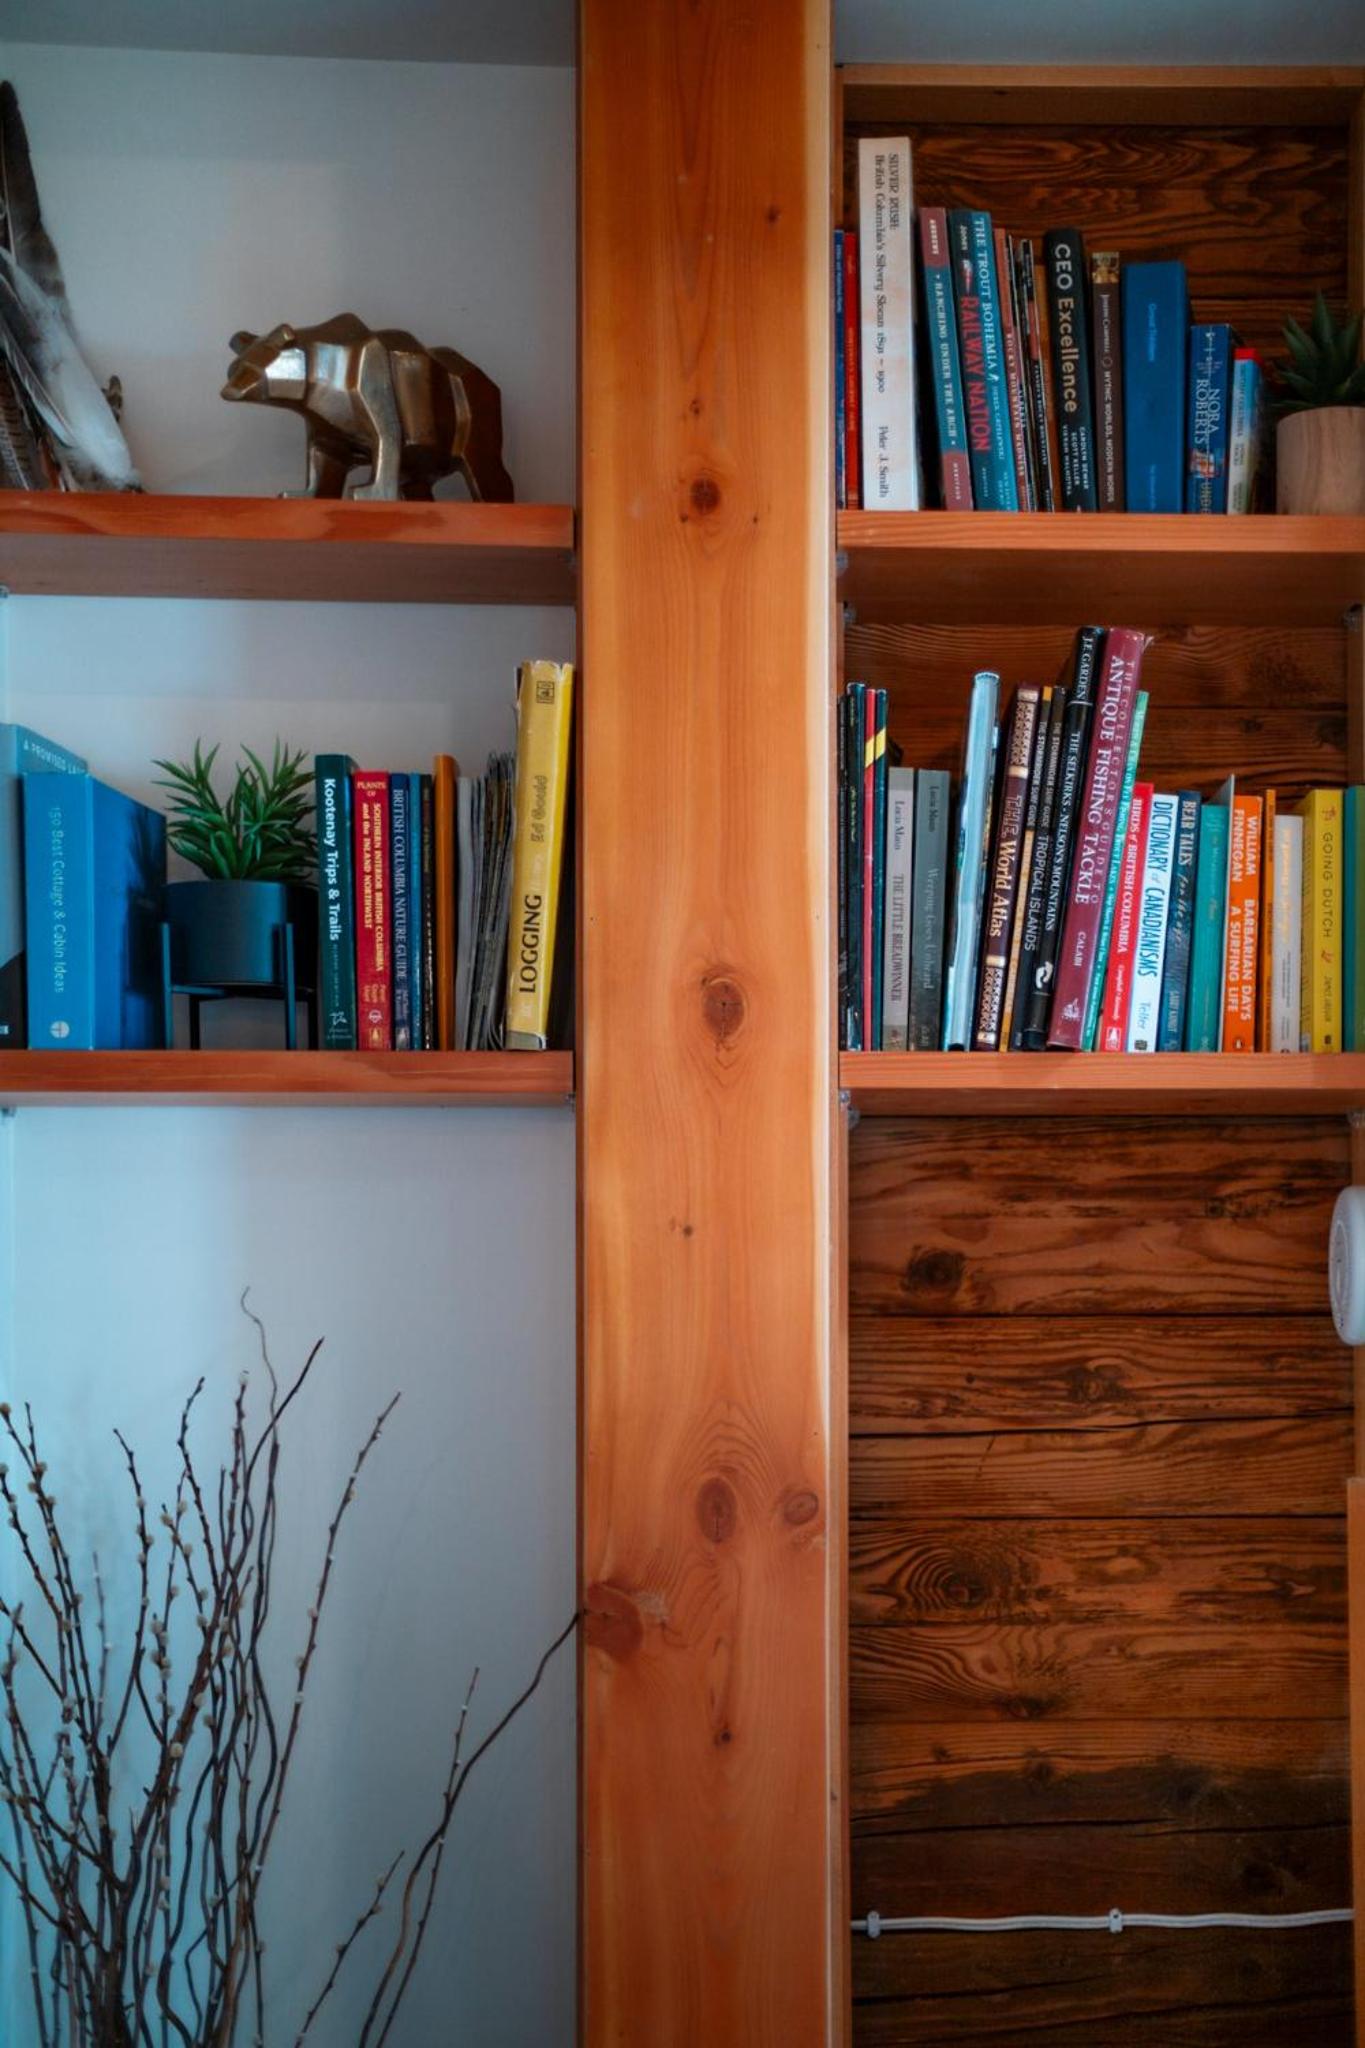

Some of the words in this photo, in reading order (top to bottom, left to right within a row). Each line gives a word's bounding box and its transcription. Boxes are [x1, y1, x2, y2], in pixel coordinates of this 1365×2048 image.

[875, 154, 886, 189] British
[888, 153, 900, 194] SILVER
[875, 193, 886, 251] Columbia's
[888, 197, 900, 230] RUSH:
[974, 217, 987, 247] THE
[873, 254, 885, 291] Silvery
[977, 250, 992, 300] TROUT
[1055, 243, 1073, 290] CEO
[934, 282, 948, 339] RANCHING
[960, 296, 984, 375] RAILWAY
[982, 302, 998, 369] BOHEMIA
[1058, 297, 1079, 413] Excellence
[940, 343, 953, 379] UNDER
[943, 383, 954, 405] THE
[967, 381, 992, 452] NATION
[1195, 379, 1209, 444] ROBERTS
[1208, 388, 1221, 434] NORA
[878, 426, 889, 450] Peter
[946, 408, 957, 437] ARCH
[879, 466, 891, 498] Smith
[1076, 653, 1092, 700] GARDEN
[1100, 655, 1124, 741] ANTIQUE
[1123, 660, 1135, 693] THE
[1037, 721, 1047, 735] THE
[1069, 731, 1081, 753] THE
[1061, 755, 1077, 806] SELKIRKS
[1088, 749, 1112, 824] FISHING
[323, 778, 337, 847] Kootenay
[362, 802, 371, 820] and
[362, 821, 371, 835] the
[373, 802, 383, 849] SOUTHERN
[393, 788, 405, 833] BRITISH
[1131, 798, 1143, 833] BIRDS
[1181, 800, 1198, 829] BEAR
[51, 829, 65, 857] Best
[363, 837, 372, 873] INLAND
[1054, 814, 1070, 865] NELSON'S
[1094, 821, 1110, 875] GUIDE
[1148, 801, 1174, 872] DICTIONARY
[1177, 833, 1195, 866] TALES
[1231, 808, 1245, 882] FINNEGAN
[1245, 815, 1258, 875] WILLIAM
[1322, 832, 1334, 881] GOING
[51, 859, 65, 908] Cottage
[324, 851, 340, 885] Trips
[374, 850, 384, 889] INTERIOR
[393, 835, 406, 895] COLUMBIA
[892, 875, 905, 895] THE
[994, 839, 1018, 889] World
[1031, 835, 1049, 894] TROPICAL
[1075, 832, 1099, 905] TACKLE
[1123, 844, 1138, 890] BRITISH
[327, 888, 340, 900] &
[364, 875, 373, 929] NORTHWEST
[374, 892, 384, 924] BRITISH
[892, 896, 905, 928] LITTLE
[924, 868, 939, 912] Weeping
[1045, 865, 1062, 931] MOUNTAINS
[1090, 883, 1102, 904] TO
[1231, 906, 1241, 916] A
[54, 911, 66, 922] &
[329, 903, 343, 941] Trails
[395, 897, 407, 942] NATURE
[989, 893, 1012, 938] Atlas
[1024, 897, 1041, 951] ISLANDS
[1117, 890, 1133, 953] COLUMBIA
[1137, 887, 1165, 977] CANADIANISMS
[1322, 888, 1333, 938] DUTCH
[54, 925, 67, 959] Cabin
[375, 925, 385, 972] COLUMBIA
[395, 943, 408, 981] GUIDE
[519, 895, 542, 993] LOGGING
[1229, 921, 1241, 982] SURFING
[1242, 899, 1255, 980] BARBARIAN
[54, 962, 67, 994] Ideas
[891, 933, 905, 1002] BREADWINNER
[922, 944, 937, 989] Unheard
[1228, 987, 1239, 1012] LIFE
[1240, 984, 1253, 1021] DAYS
